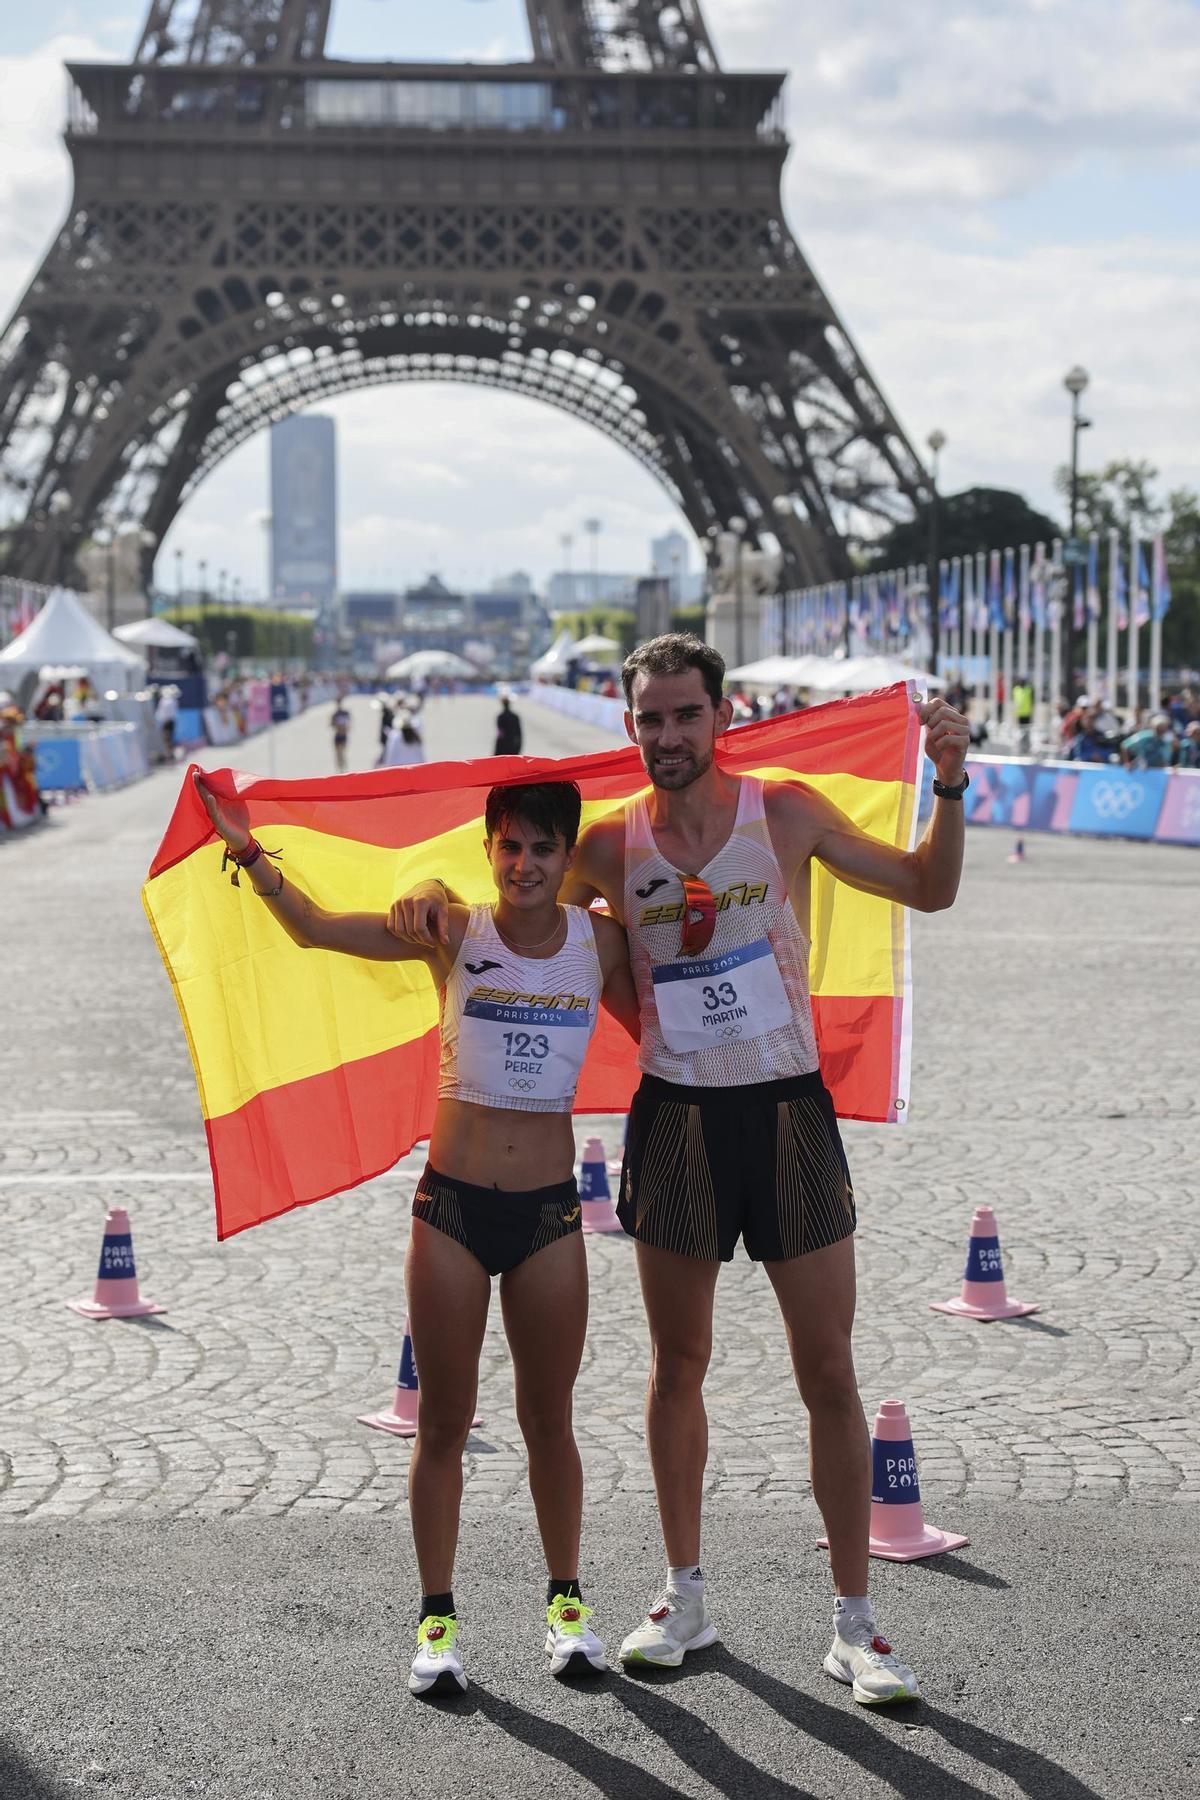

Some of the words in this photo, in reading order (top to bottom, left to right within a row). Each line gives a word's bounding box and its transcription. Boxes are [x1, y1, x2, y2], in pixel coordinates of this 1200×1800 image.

[683, 964, 710, 974] PARIS
[713, 955, 740, 971] 2024
[467, 984, 590, 1011] ESPAÑA
[702, 982, 738, 1010] 33
[496, 1009, 529, 1020] PARIS
[533, 1012, 562, 1021] 2024
[702, 1005, 748, 1027] MARTIN
[502, 1031, 550, 1059] 123
[504, 1060, 543, 1074] PEREZ
